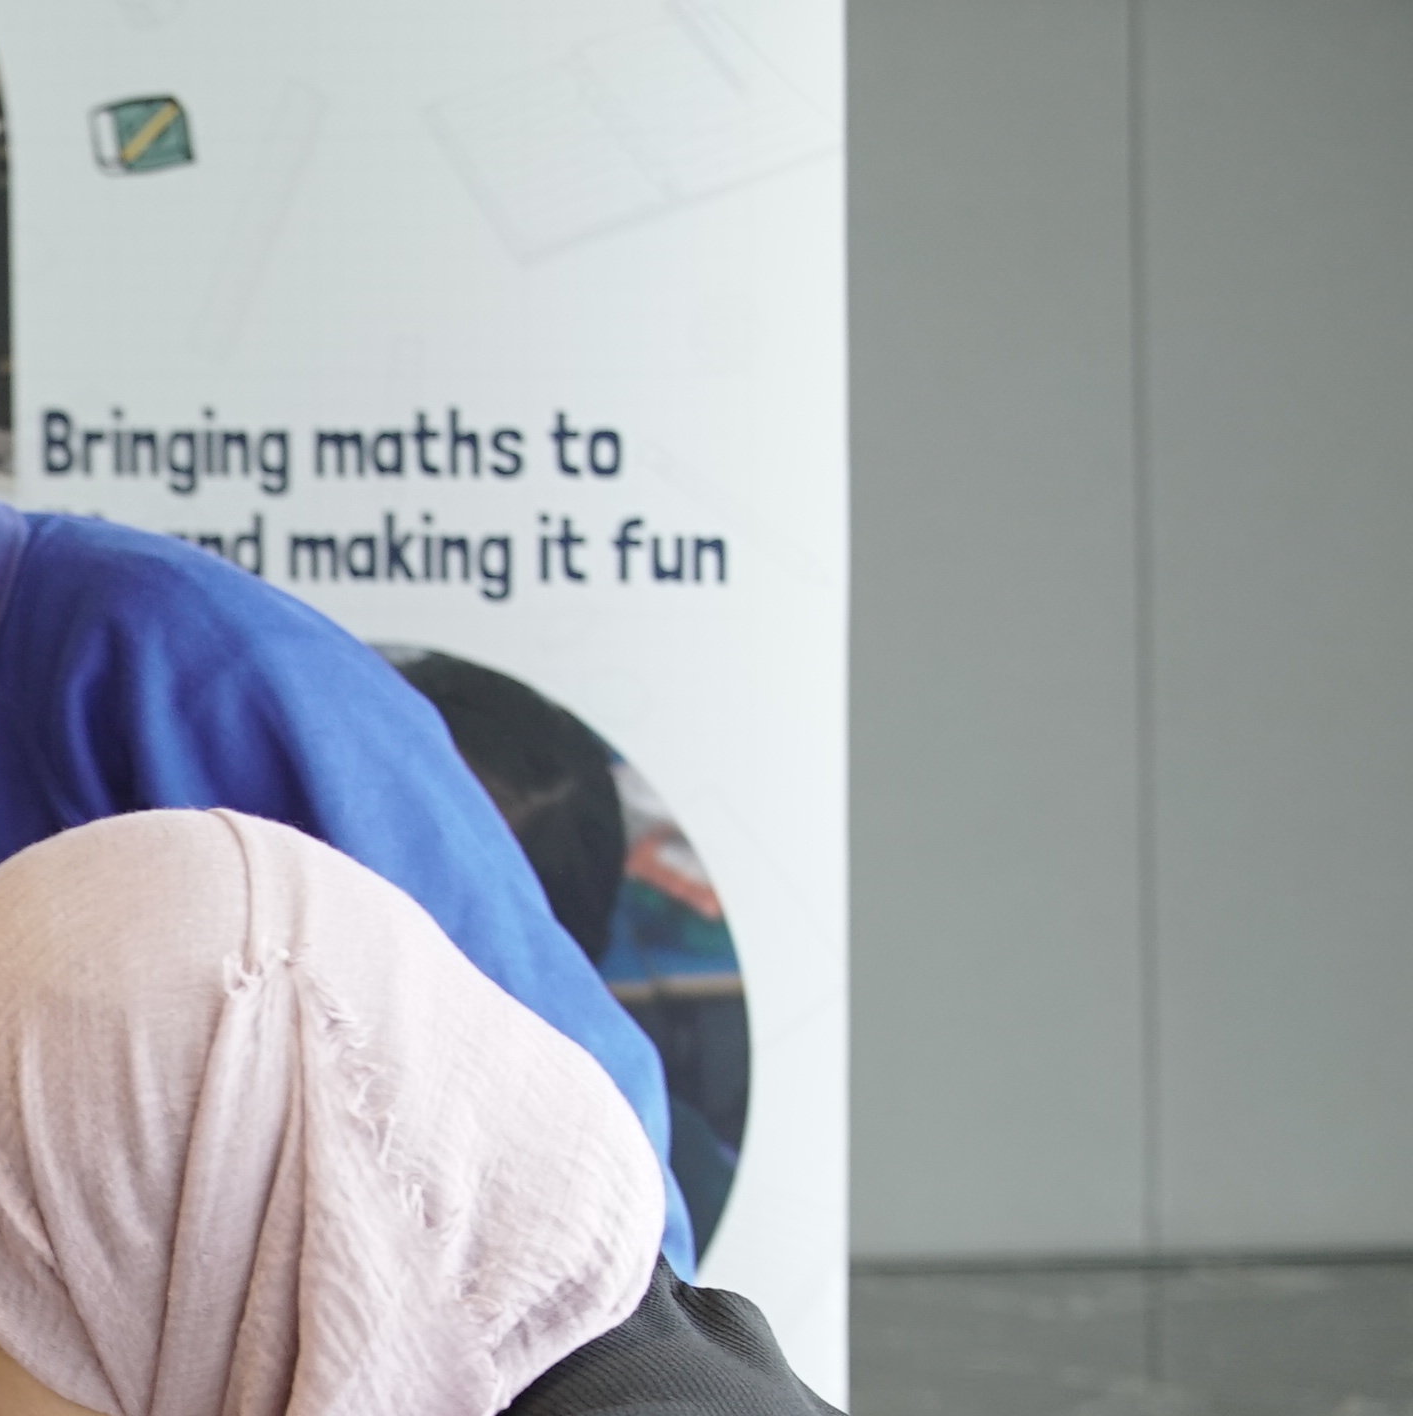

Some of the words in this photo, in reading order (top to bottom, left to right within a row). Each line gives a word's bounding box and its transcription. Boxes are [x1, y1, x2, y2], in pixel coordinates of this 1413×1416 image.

[42, 409, 290, 494] Bringing
[314, 408, 524, 478] maths
[551, 411, 623, 478] to
[178, 513, 265, 577] nd
[289, 512, 511, 602] making
[538, 513, 587, 583] it
[613, 517, 728, 583] fun
